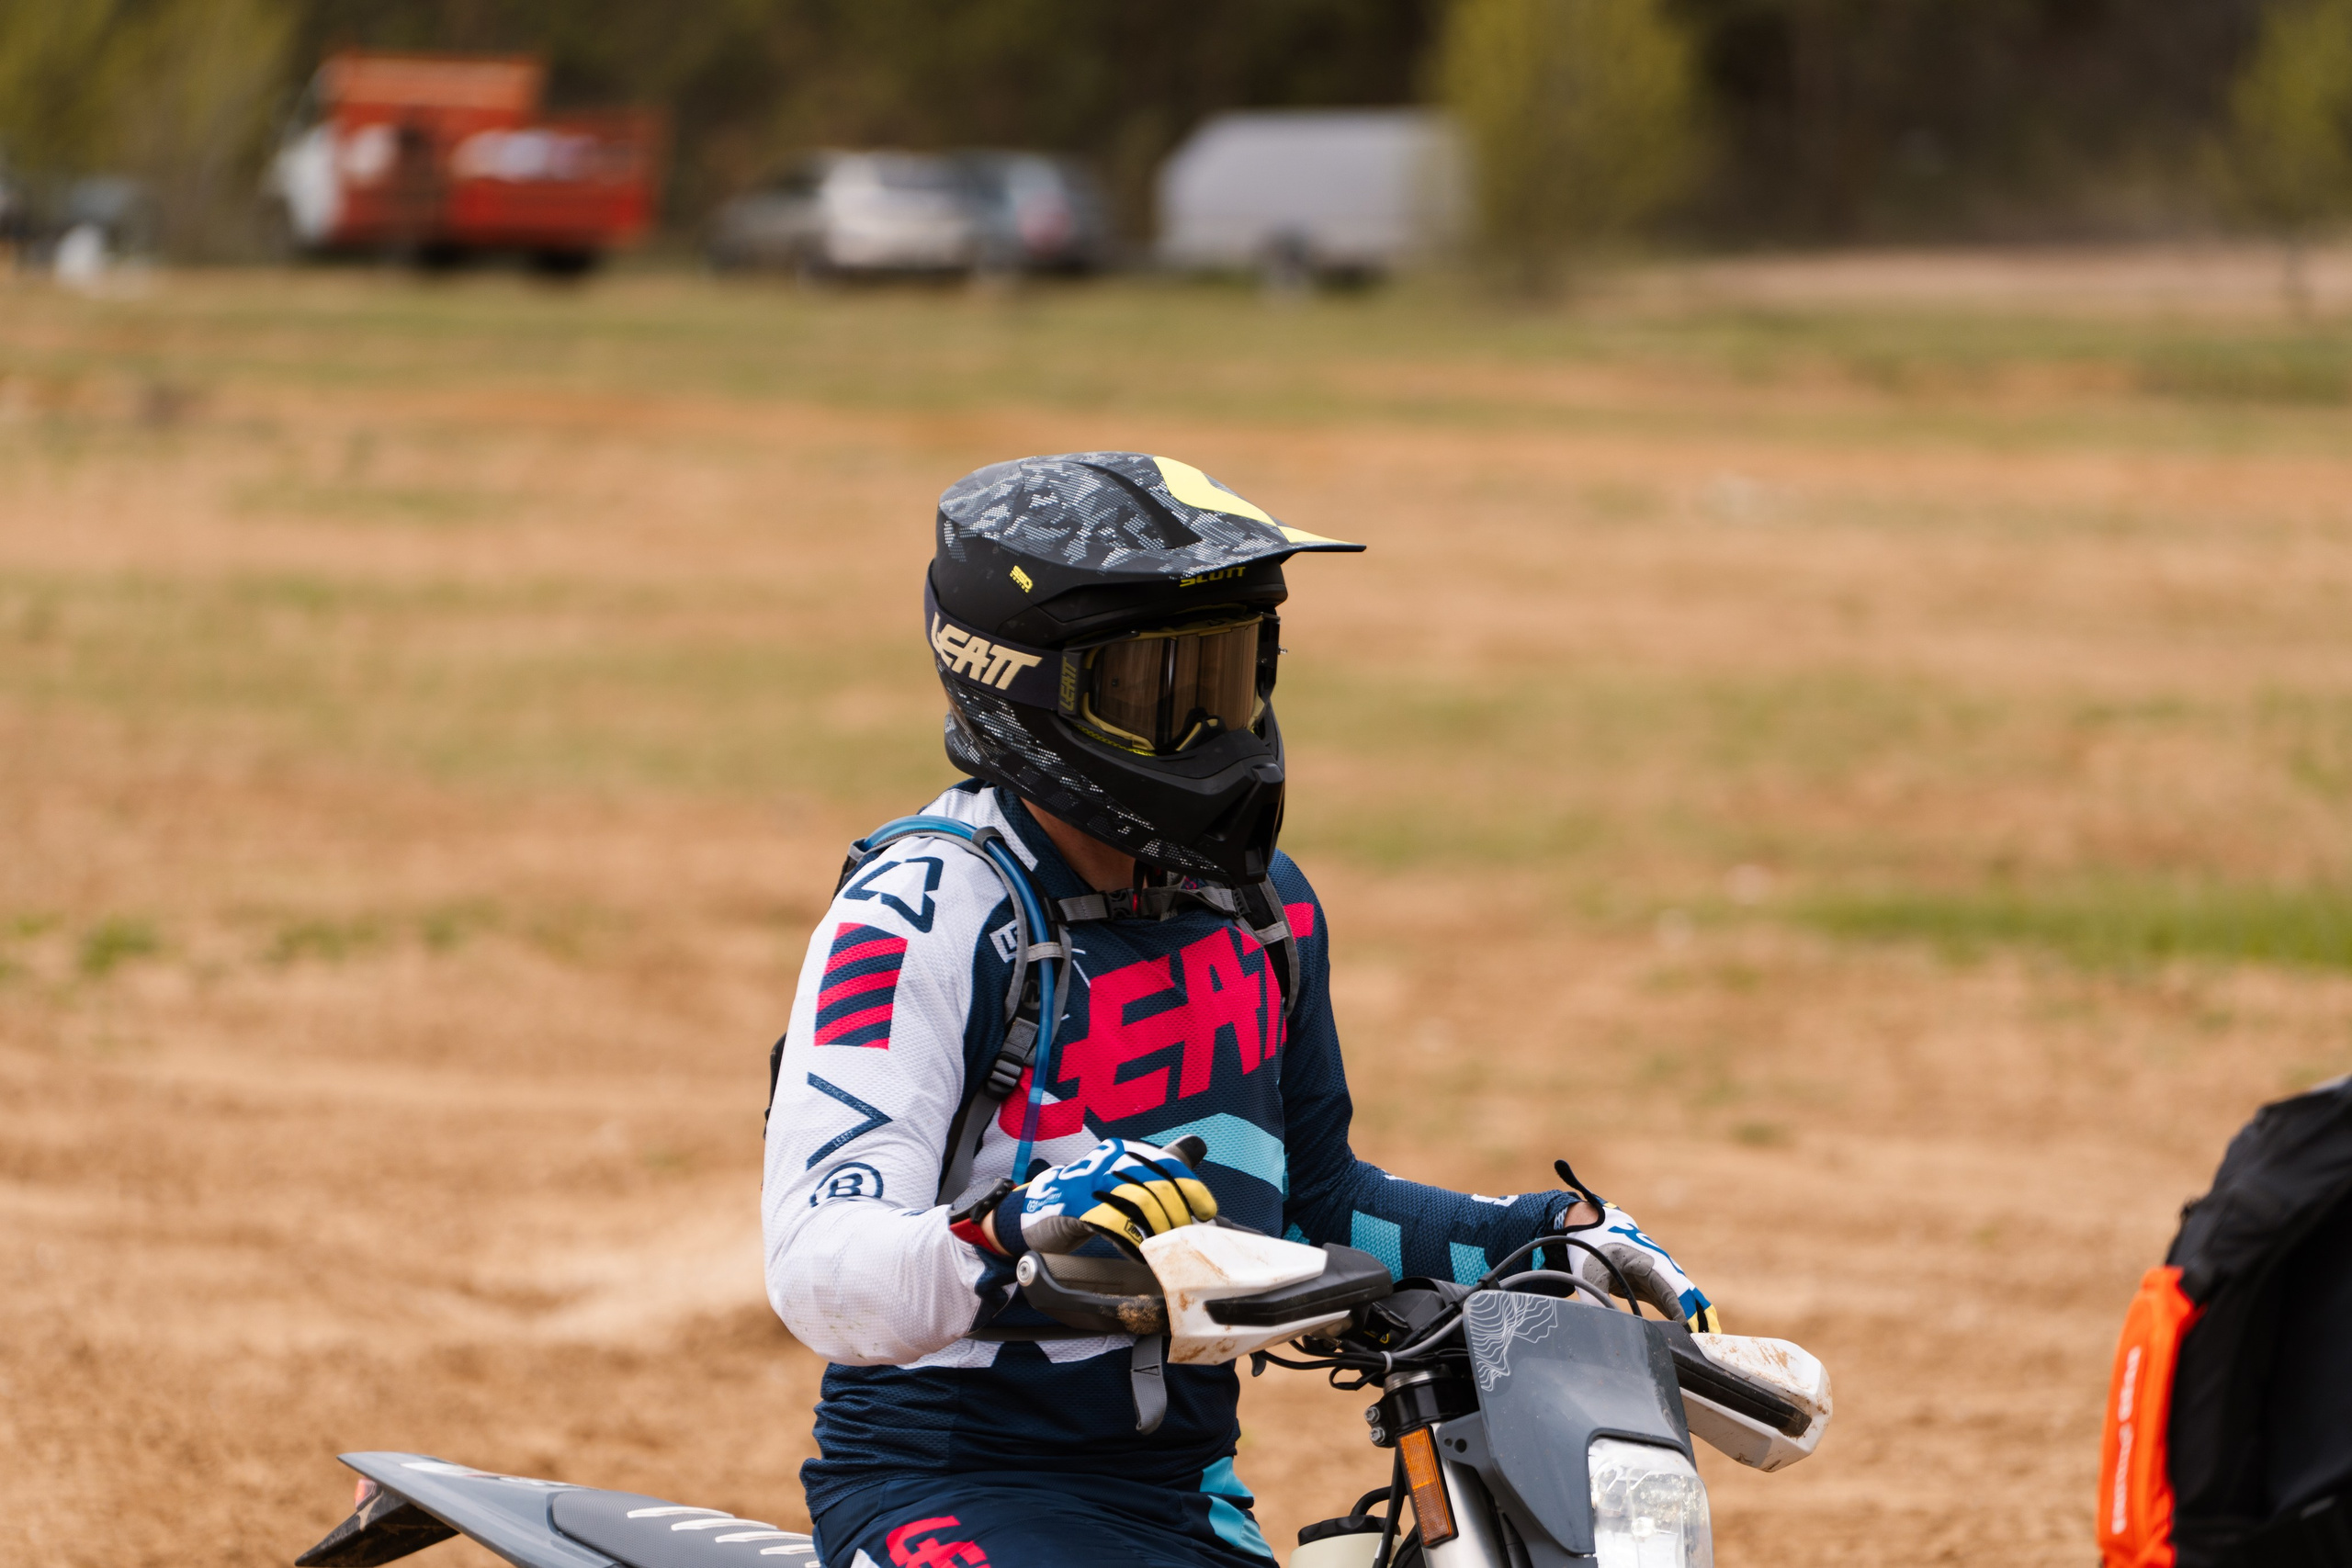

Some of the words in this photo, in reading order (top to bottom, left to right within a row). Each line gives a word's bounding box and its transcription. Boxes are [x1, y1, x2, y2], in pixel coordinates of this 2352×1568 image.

[931, 612, 1044, 691] LEATT
[1060, 656, 1078, 712] LEATT
[813, 1078, 848, 1101] SCIENCE
[832, 1130, 854, 1147] LEATT
